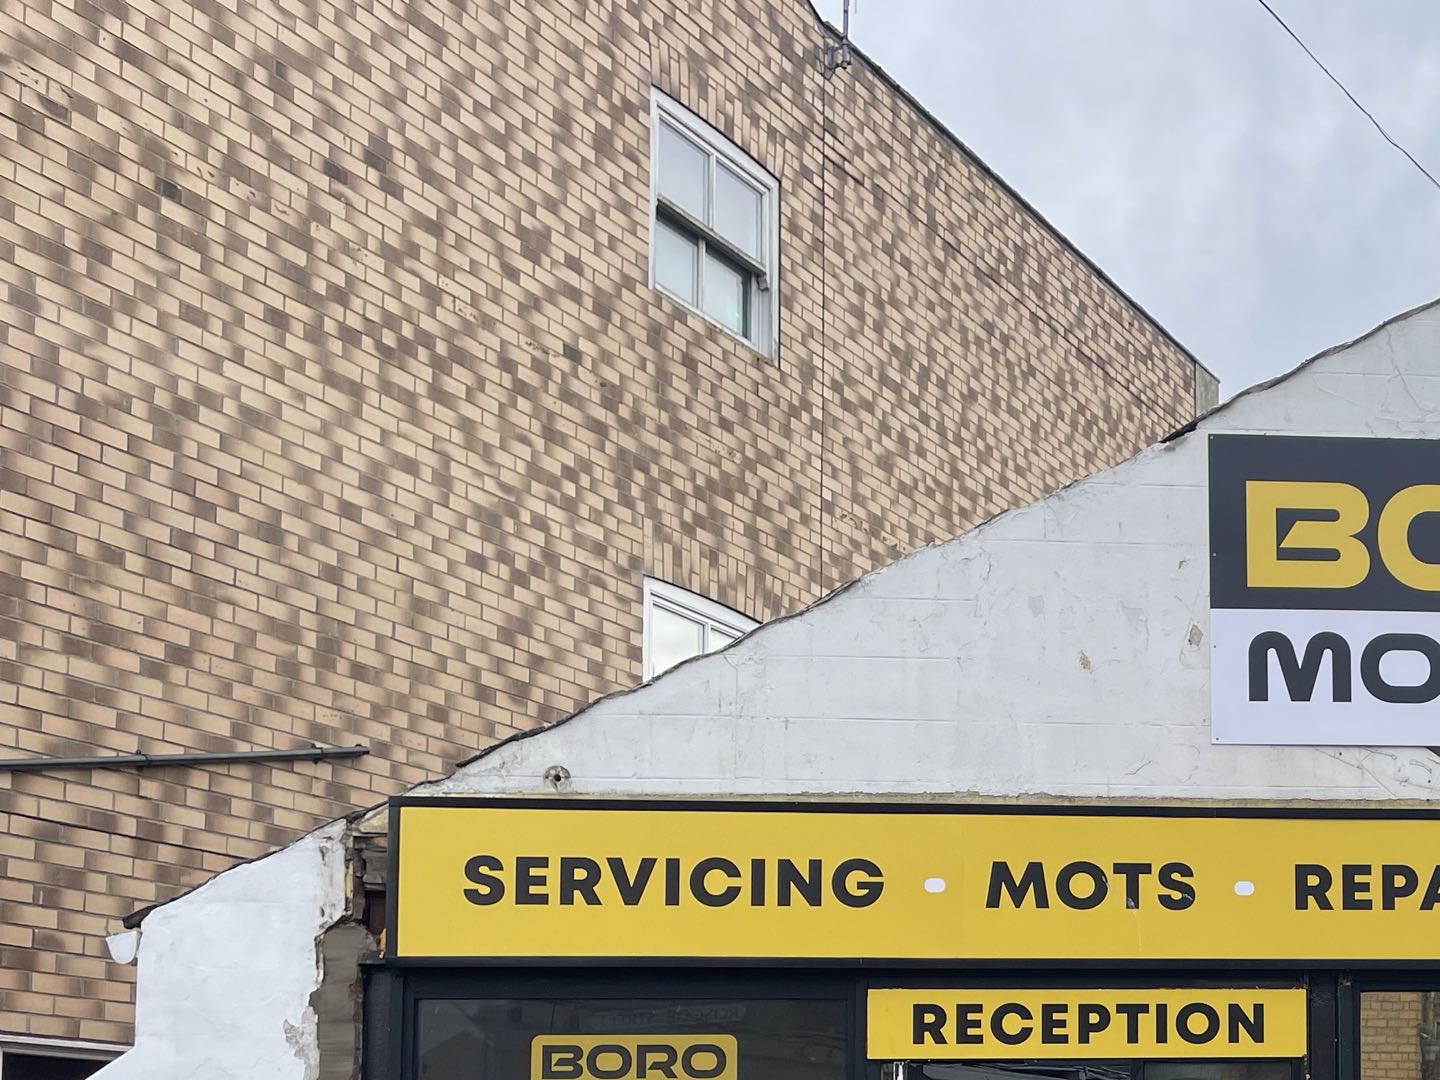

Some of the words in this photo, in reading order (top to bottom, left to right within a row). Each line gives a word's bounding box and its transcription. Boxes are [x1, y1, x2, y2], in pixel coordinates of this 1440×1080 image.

[463, 855, 885, 909] SERVICING
[985, 861, 1196, 911] MOTS
[912, 1003, 1266, 1046] RECEPTION
[541, 1044, 728, 1080] BORO
